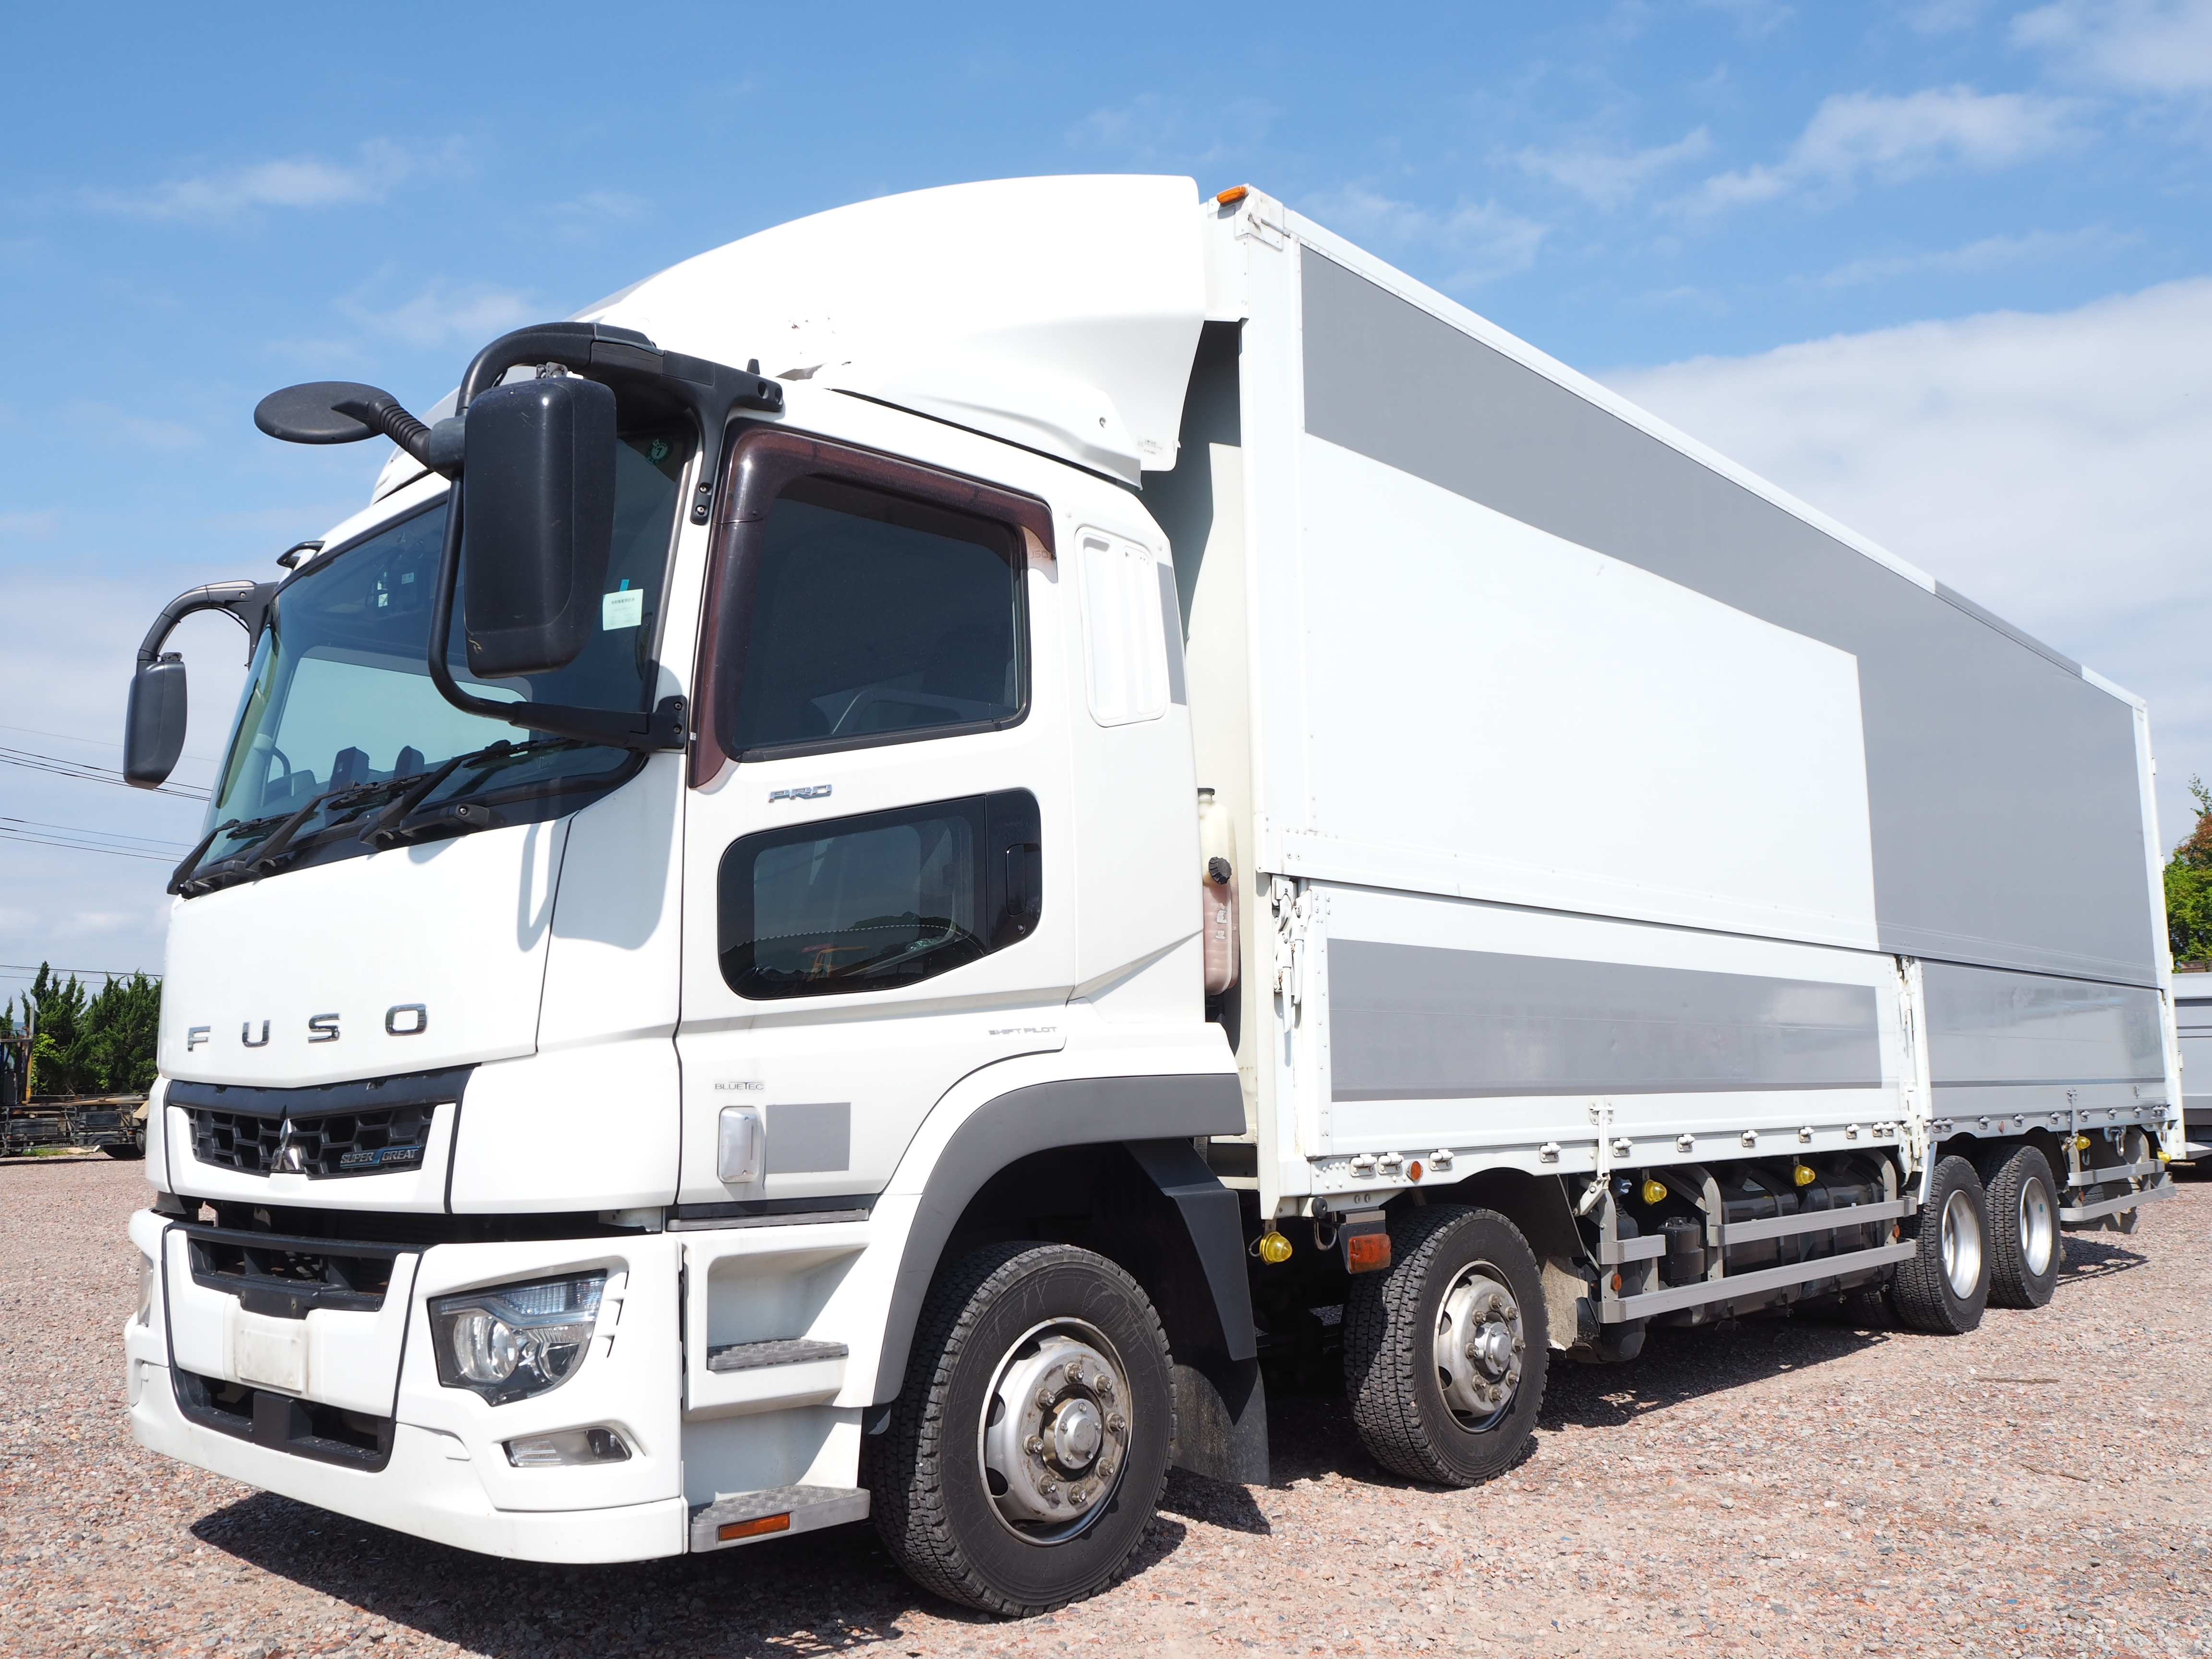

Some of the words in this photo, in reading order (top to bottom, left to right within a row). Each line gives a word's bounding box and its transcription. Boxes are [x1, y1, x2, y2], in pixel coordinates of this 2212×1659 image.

[768, 784, 832, 804] PRO
[187, 1003, 428, 1052] FUSO
[340, 1152, 374, 1164] SUPER
[382, 1149, 419, 1161] GREAT
